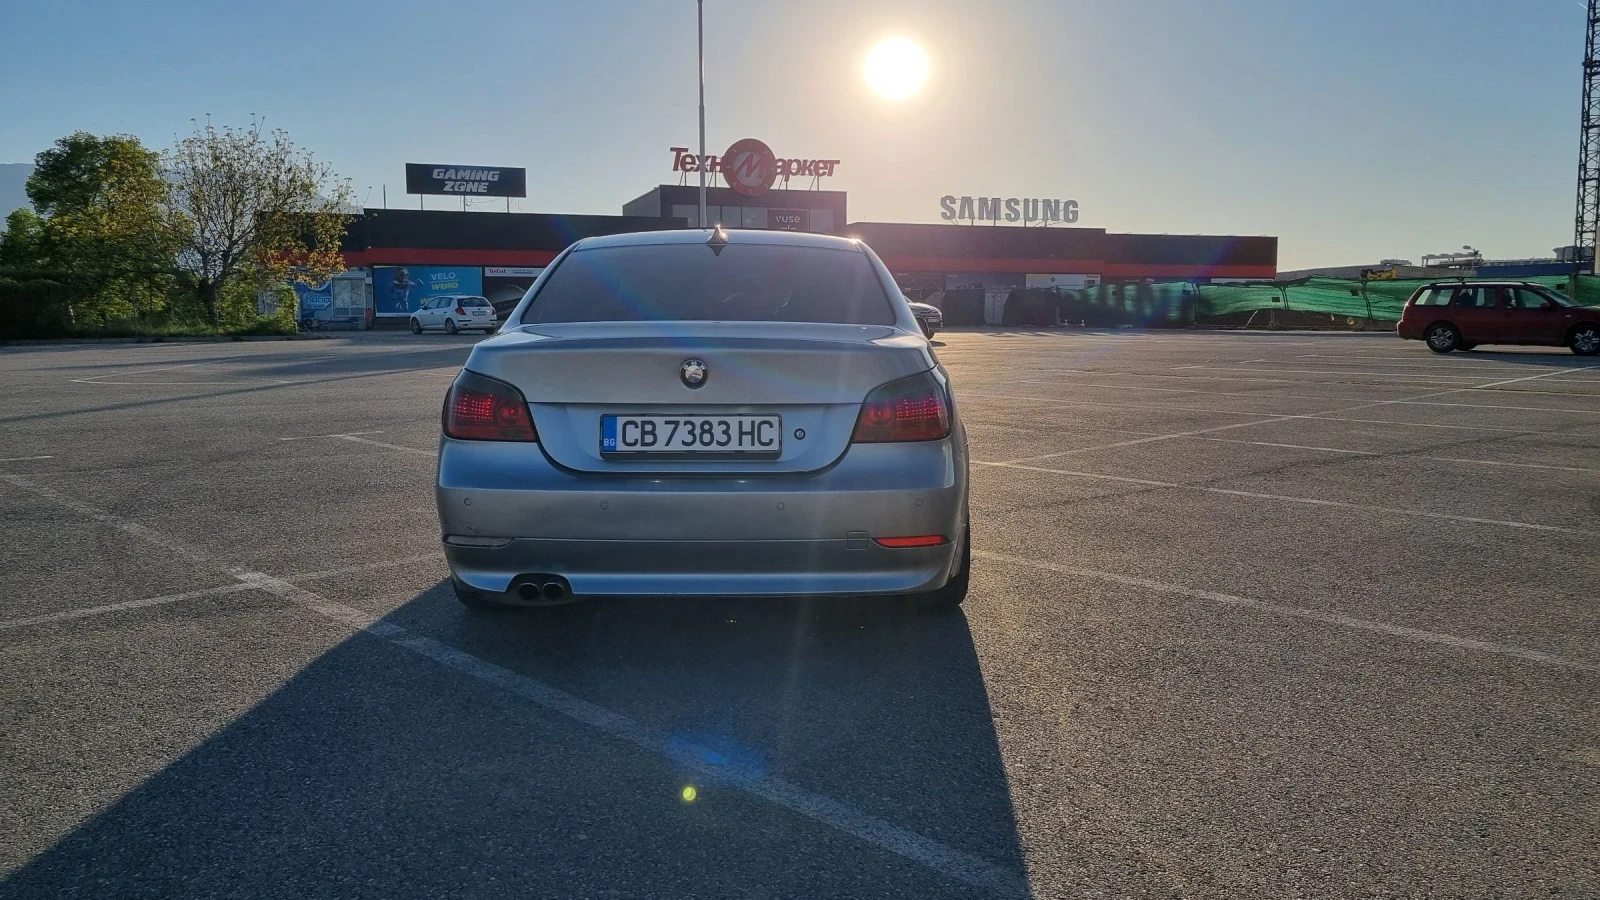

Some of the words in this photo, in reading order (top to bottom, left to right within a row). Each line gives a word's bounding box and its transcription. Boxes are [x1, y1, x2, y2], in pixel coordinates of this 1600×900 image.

[432, 168, 500, 181] GAMING
[443, 181, 489, 193] ZONE
[940, 194, 1079, 224] SAMSUNG
[774, 215, 801, 223] vuse
[430, 272, 456, 281] VELO
[431, 282, 459, 291] WEIRD
[621, 420, 658, 447] CB
[664, 420, 732, 447] 7383
[738, 420, 774, 447] HC
[603, 438, 616, 447] BG
